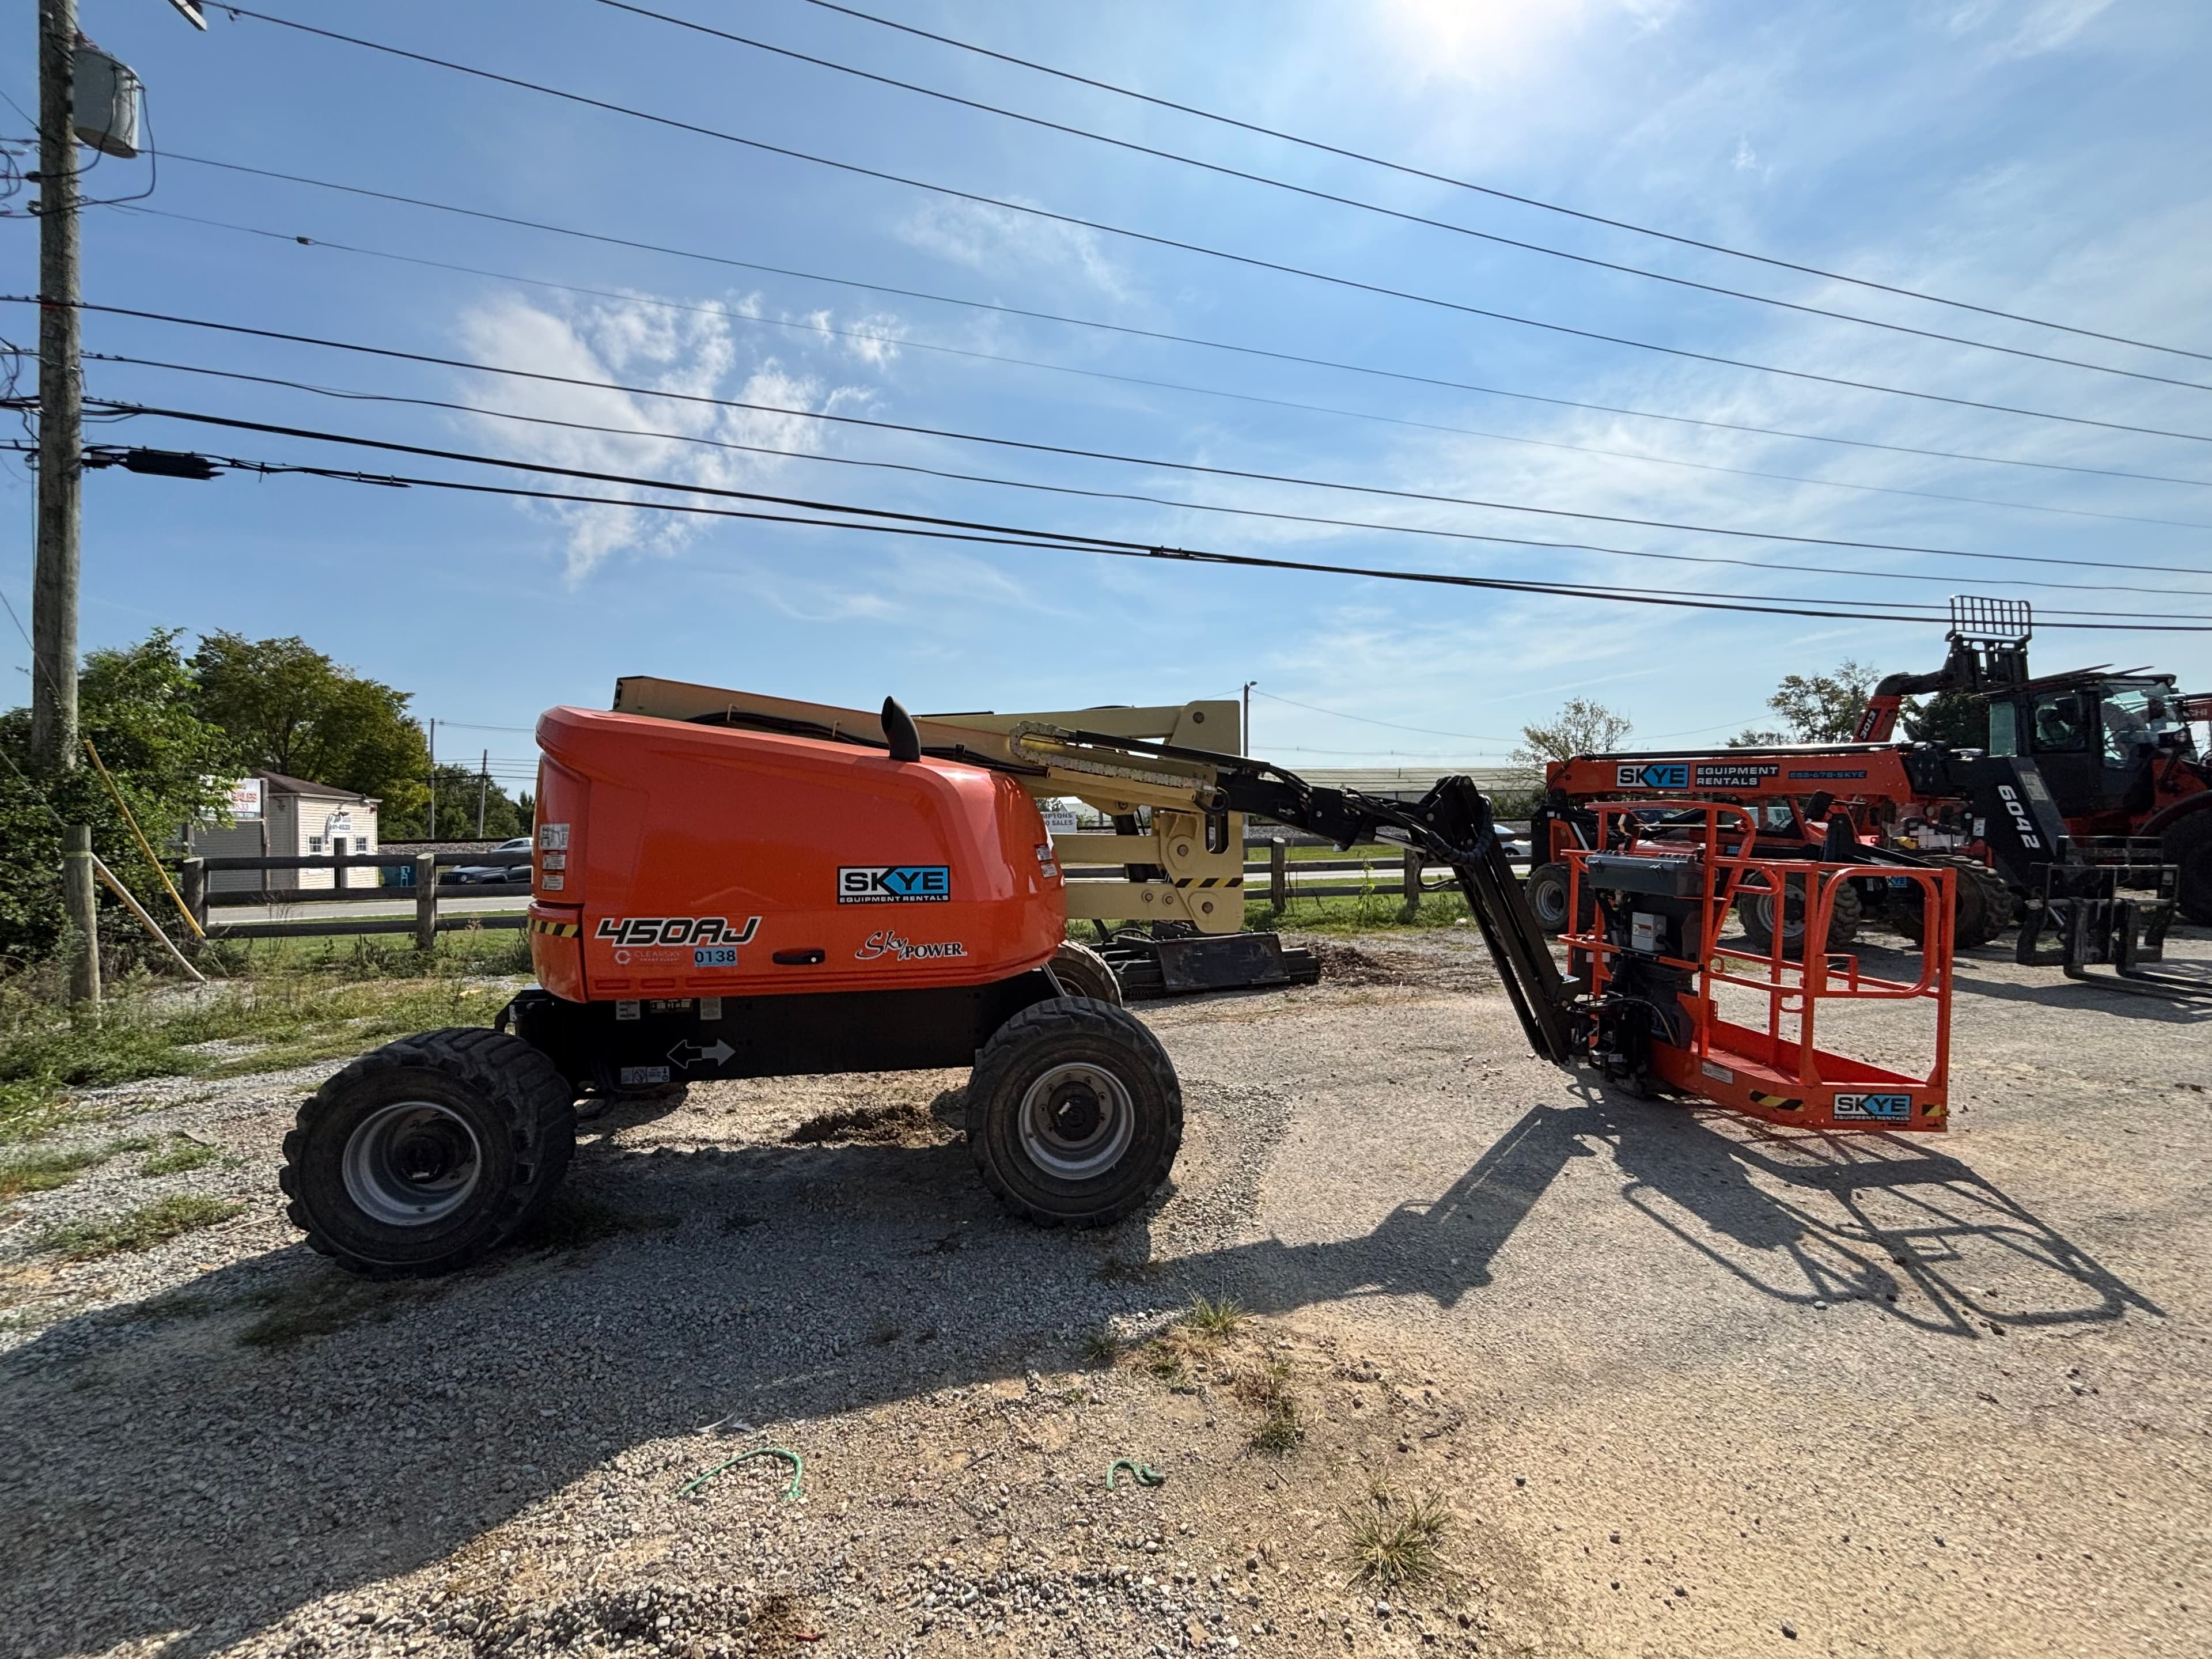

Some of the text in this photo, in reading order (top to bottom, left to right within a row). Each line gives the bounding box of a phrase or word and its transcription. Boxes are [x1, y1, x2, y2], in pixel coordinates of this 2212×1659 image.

[1859, 710, 1876, 740] 3013
[1620, 768, 1685, 784] SKYE
[1697, 767, 1778, 775] EQUIPMENT
[1998, 785, 2040, 848] 6042
[844, 871, 944, 892] SKYE
[597, 917, 760, 946] 450AJ
[694, 950, 736, 963] 0138
[1838, 1097, 1907, 1112] SKYE
